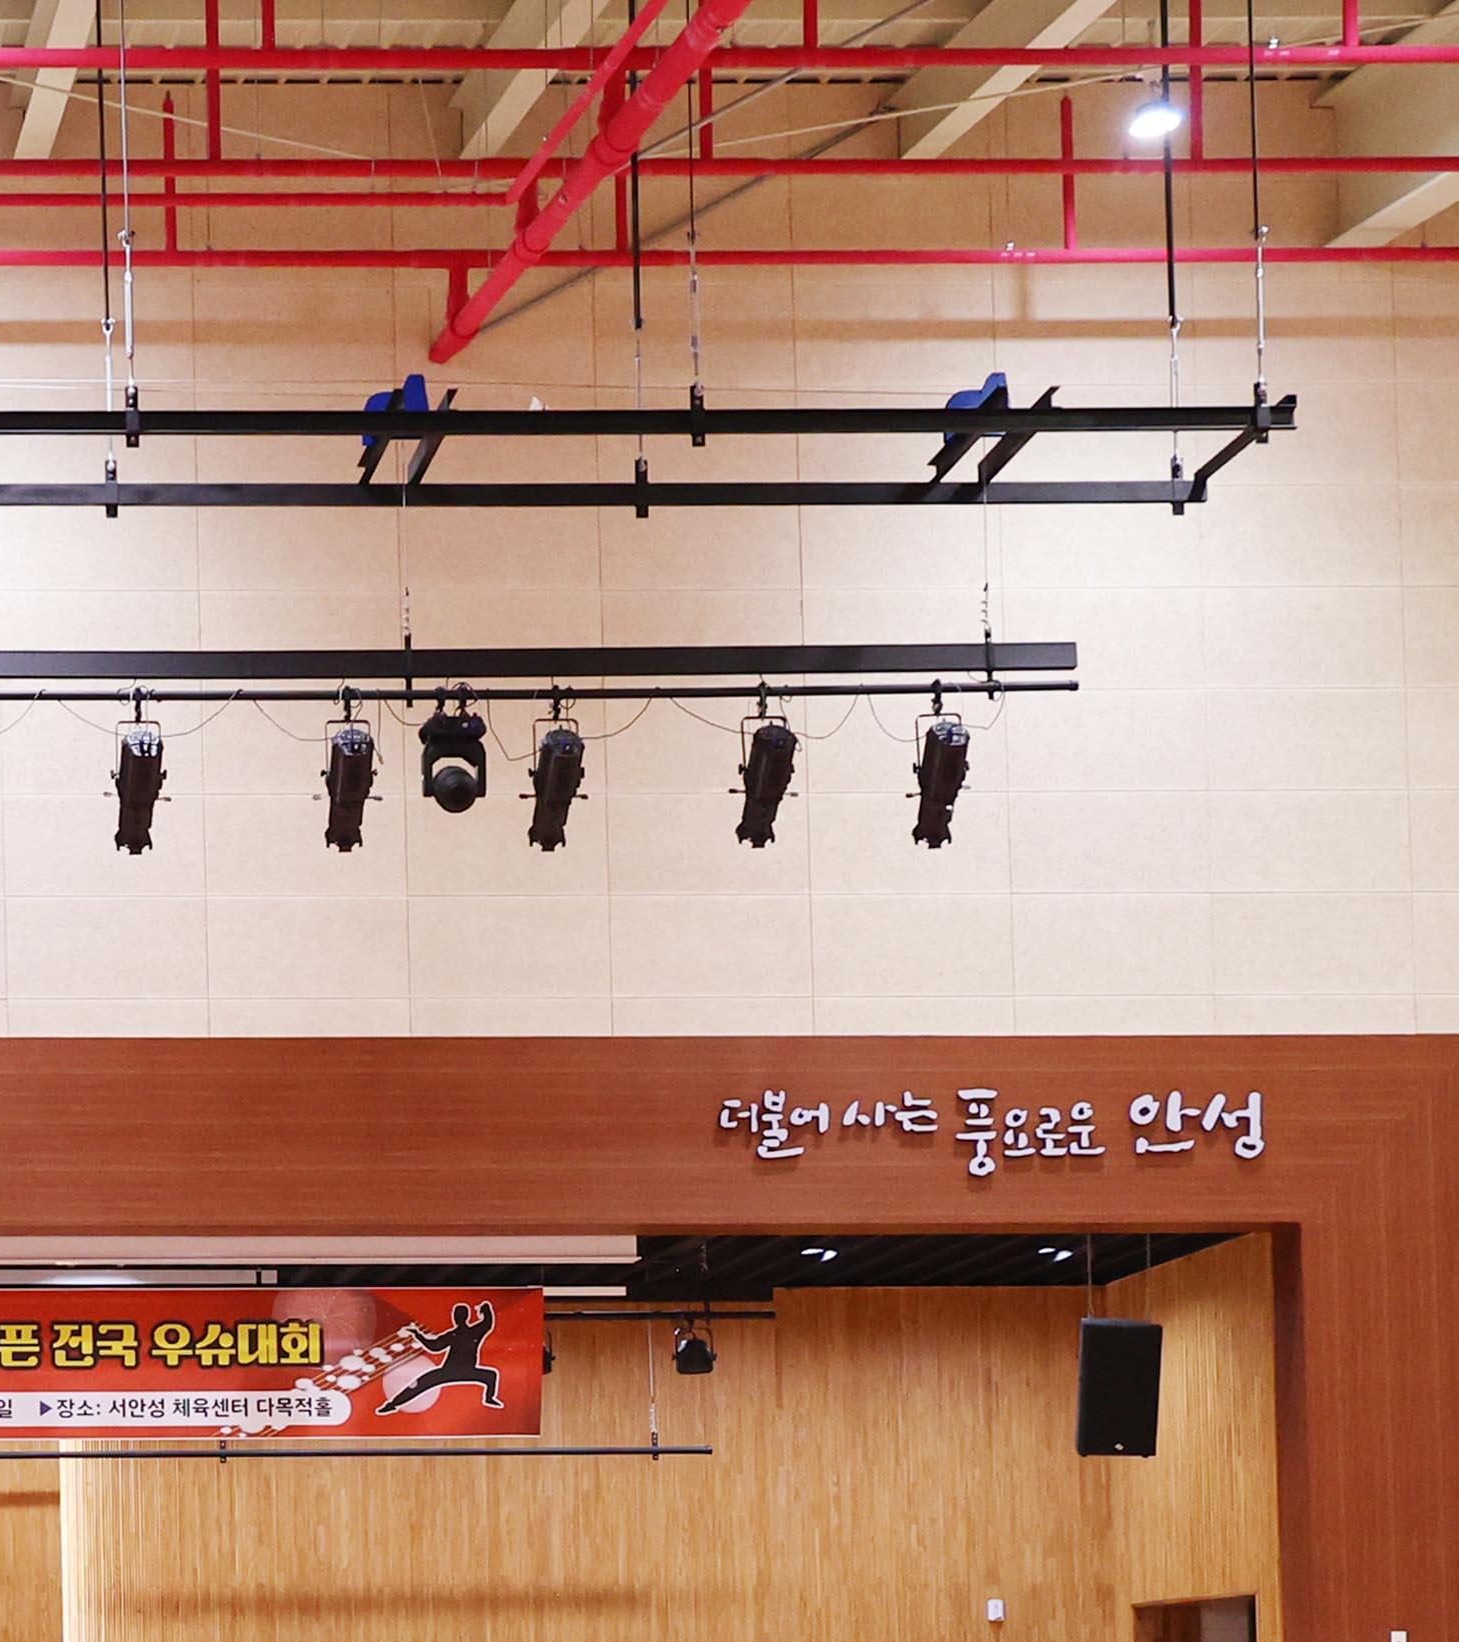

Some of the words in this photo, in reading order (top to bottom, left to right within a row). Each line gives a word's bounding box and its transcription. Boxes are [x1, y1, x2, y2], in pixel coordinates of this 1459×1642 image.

[720, 1090, 829, 1158] 더불어
[842, 1091, 939, 1132] 사는
[955, 1088, 1106, 1176] 풍요로운
[1130, 1091, 1265, 1159] 안성
[52, 1324, 138, 1367] 전국
[151, 1323, 322, 1367] 우슈대회
[57, 1398, 101, 1419] 장소:
[109, 1398, 165, 1419] 서안성
[173, 1397, 248, 1418] 체육센터
[256, 1397, 333, 1417] 다목적홀
